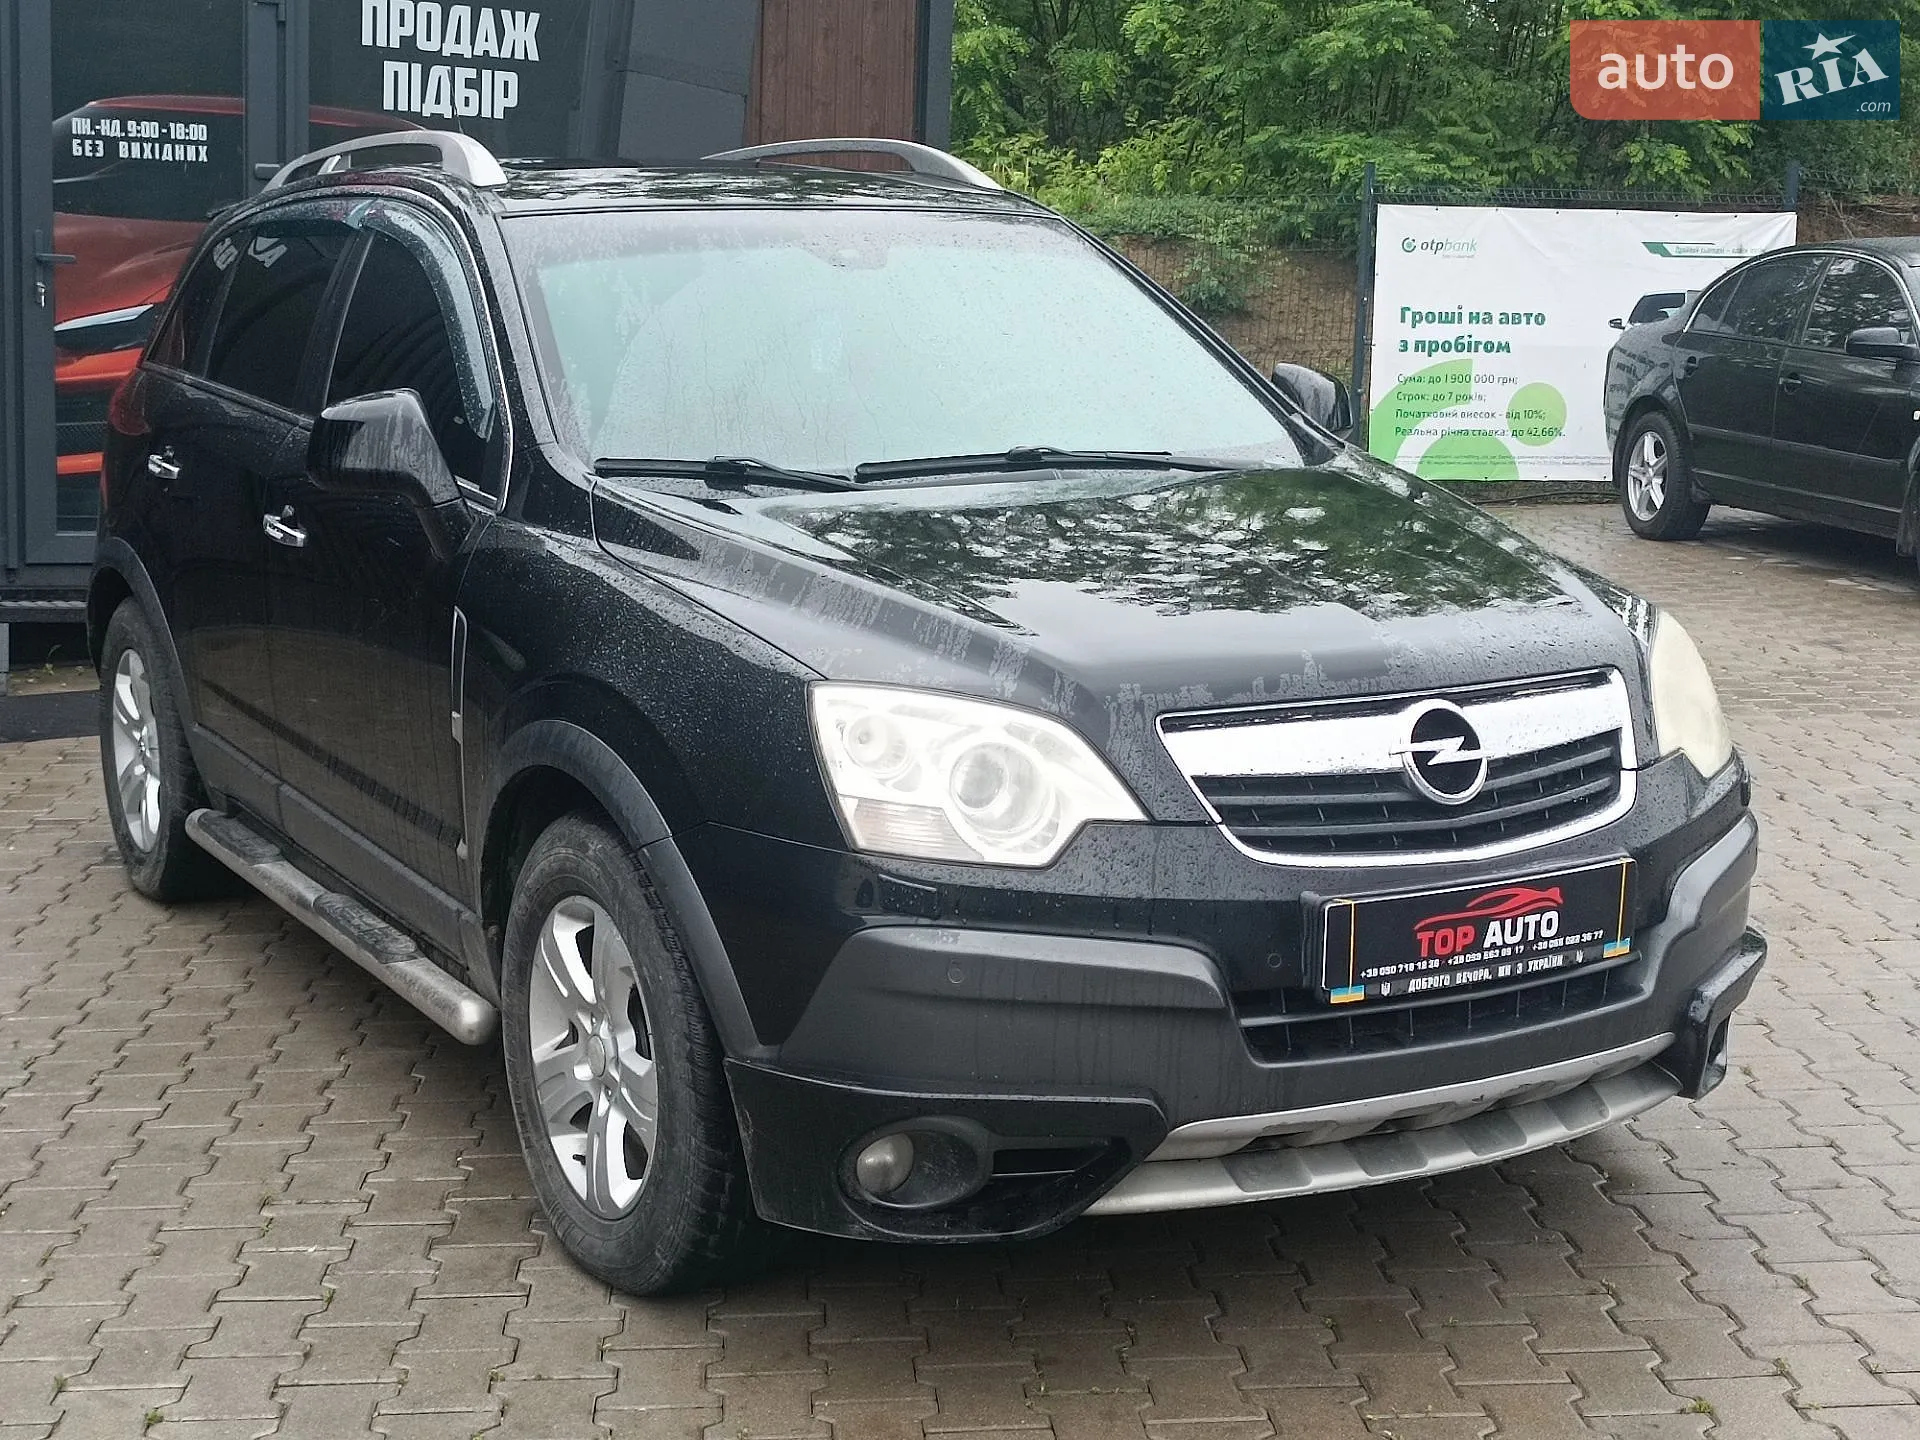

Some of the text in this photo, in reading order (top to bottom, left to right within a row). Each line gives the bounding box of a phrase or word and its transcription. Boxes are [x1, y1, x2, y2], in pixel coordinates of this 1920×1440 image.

[362, 0, 540, 61] ПРОДАЖ
[383, 60, 519, 119] ПІДБІР
[72, 138, 208, 162] БЕЗ ВИХІДНИХ
[1400, 304, 1546, 329] Гроші на авто
[1398, 334, 1511, 357] з пробігом
[1397, 373, 1426, 385] Сума:
[1428, 375, 1442, 385] до
[1497, 375, 1518, 387] грн;
[1396, 391, 1487, 403] Строк: до 7 років;
[1395, 408, 1459, 420] Початковий
[1505, 409, 1521, 420] від
[1395, 426, 1439, 437] Реальна
[1441, 426, 1469, 438] річна
[1471, 427, 1509, 437] ставка:
[1511, 428, 1525, 438] до
[1417, 911, 1559, 957] TOP AUTO
[1408, 973, 1450, 993] ДОБРОГО
